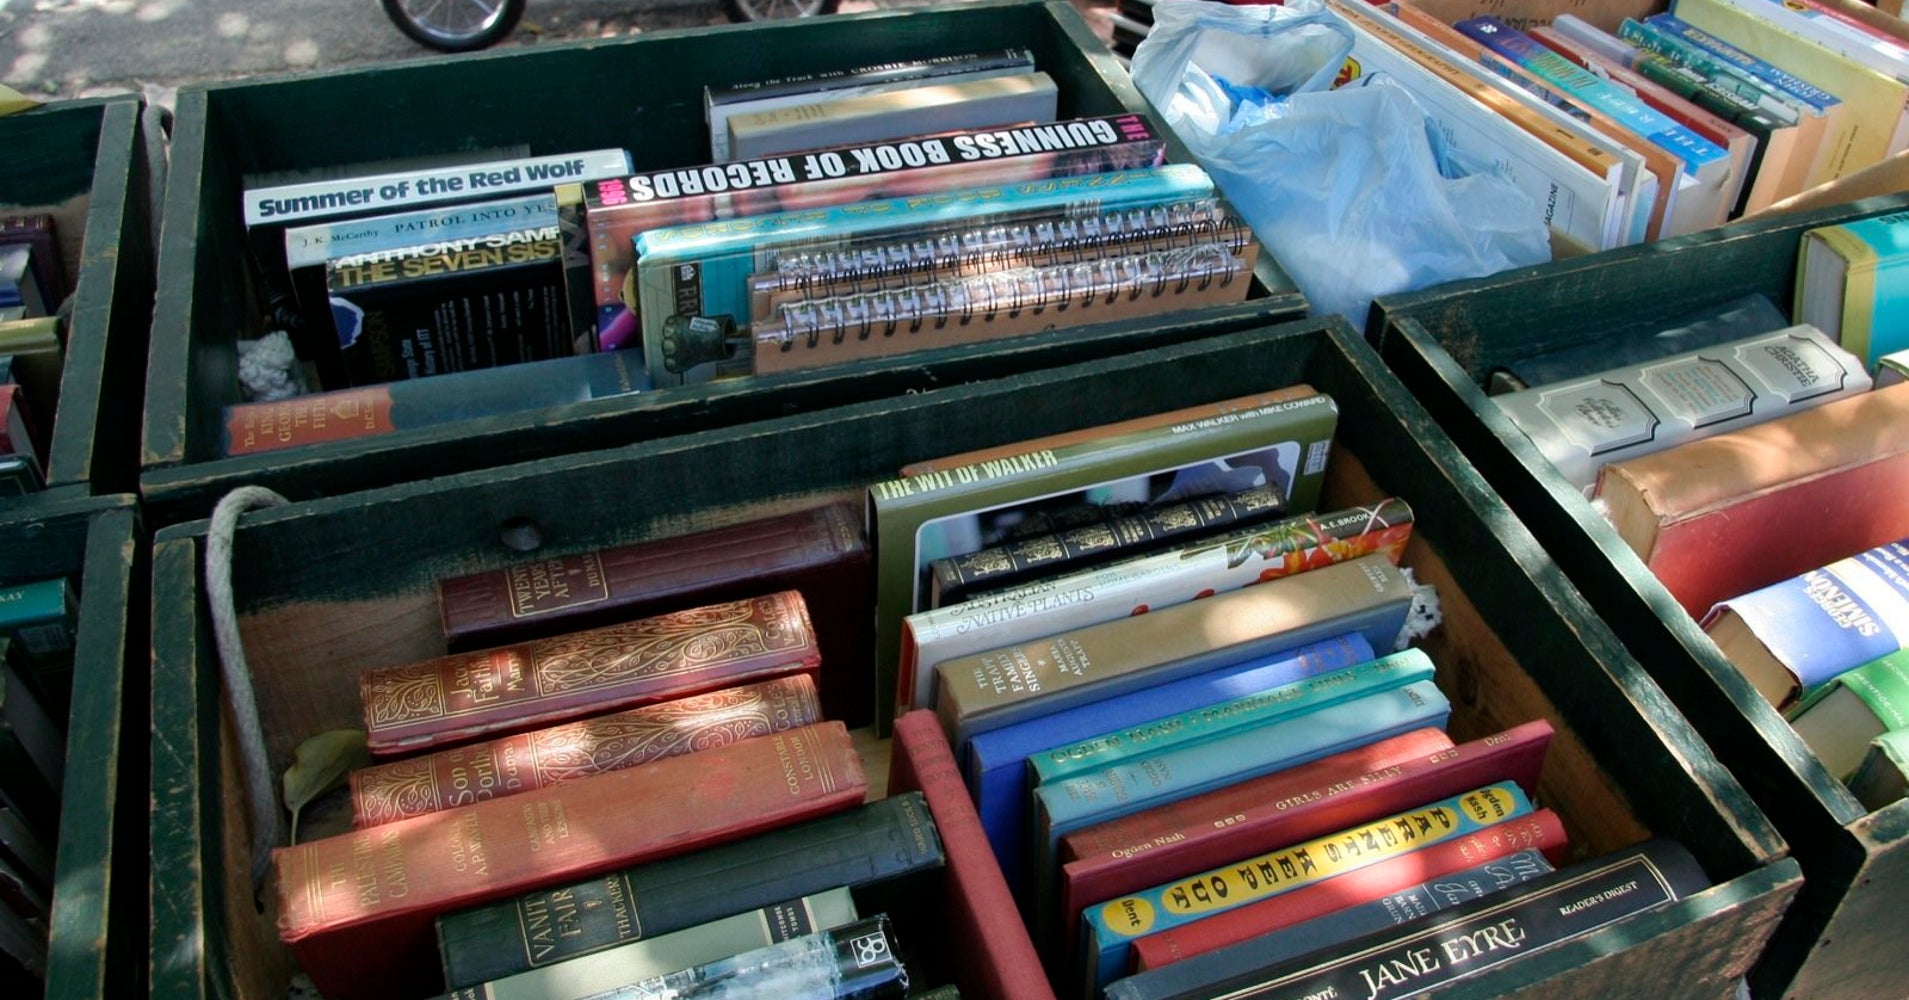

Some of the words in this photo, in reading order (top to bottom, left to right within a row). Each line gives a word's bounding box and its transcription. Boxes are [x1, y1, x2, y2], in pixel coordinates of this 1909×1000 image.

[953, 118, 1119, 161] GUINNESS
[1115, 114, 1150, 141] THE
[804, 151, 847, 181] OF
[849, 140, 951, 175] BOOK
[258, 190, 375, 218] Summer
[379, 180, 411, 201] of
[416, 175, 463, 197] the
[469, 166, 522, 189] Red
[528, 158, 586, 182] Wolf
[628, 156, 797, 202] RECORDS
[331, 228, 380, 242] McCarthy
[394, 215, 467, 234] PATROL
[472, 207, 517, 224] INTO
[334, 236, 485, 269] ANTHONY
[336, 263, 398, 288] THE
[402, 248, 502, 279] SEVEN
[1764, 344, 1813, 389] CHRISTIE
[1774, 344, 1820, 384] AGATHA
[1172, 422, 1197, 435] MAX
[1198, 414, 1240, 430] WALKER
[1240, 408, 1259, 422] with
[1259, 403, 1284, 418] MIKE
[1282, 396, 1326, 412] COWARD
[876, 478, 916, 501] THE
[915, 470, 955, 494] WIT
[956, 463, 980, 485] OF
[983, 449, 1059, 480] WALKER
[950, 580, 1057, 617] AUSTRALIAN
[956, 598, 1031, 635] NATIVE
[1029, 586, 1095, 614] PLANTS
[1801, 570, 1881, 637] SIMENON
[998, 652, 1020, 693] FAMILY
[1011, 645, 1041, 693] SINGERS
[1050, 645, 1070, 674] MARIA
[1070, 639, 1092, 670] TRAPP
[973, 667, 989, 689] THE
[981, 657, 1004, 695] TRAPP
[791, 735, 815, 782] LONDON
[1050, 735, 1122, 764] OGDEN
[1125, 718, 1185, 743] NASH
[504, 740, 523, 791] Dumas
[771, 735, 802, 796] CONSTABLE
[449, 766, 475, 807] Son
[1111, 841, 1153, 861] Ogden
[1154, 832, 1187, 850] Nash
[1275, 789, 1322, 812] GIRLS
[1327, 779, 1355, 798] ARE
[1359, 765, 1404, 788] SILLY
[1484, 732, 1511, 748] Dent
[1479, 787, 1506, 818] Ogden
[1466, 795, 1488, 821] Nash
[449, 819, 468, 873] COLONEL
[542, 822, 556, 846] AND
[1325, 807, 1451, 863] PARENTS
[352, 834, 381, 908] PALESTINE
[380, 827, 409, 899] CAMPAIGNS
[1236, 847, 1316, 891] KEEP
[606, 874, 632, 939] THACKER
[1170, 874, 1230, 910] OUT
[1382, 897, 1403, 925] GRUN
[552, 887, 583, 939] FAIR
[1120, 898, 1142, 928] Dent
[1358, 948, 1441, 1000] JANE
[1440, 918, 1527, 965] EYRE
[1559, 891, 1605, 917] READER'S
[1603, 880, 1638, 901] DIGEST
